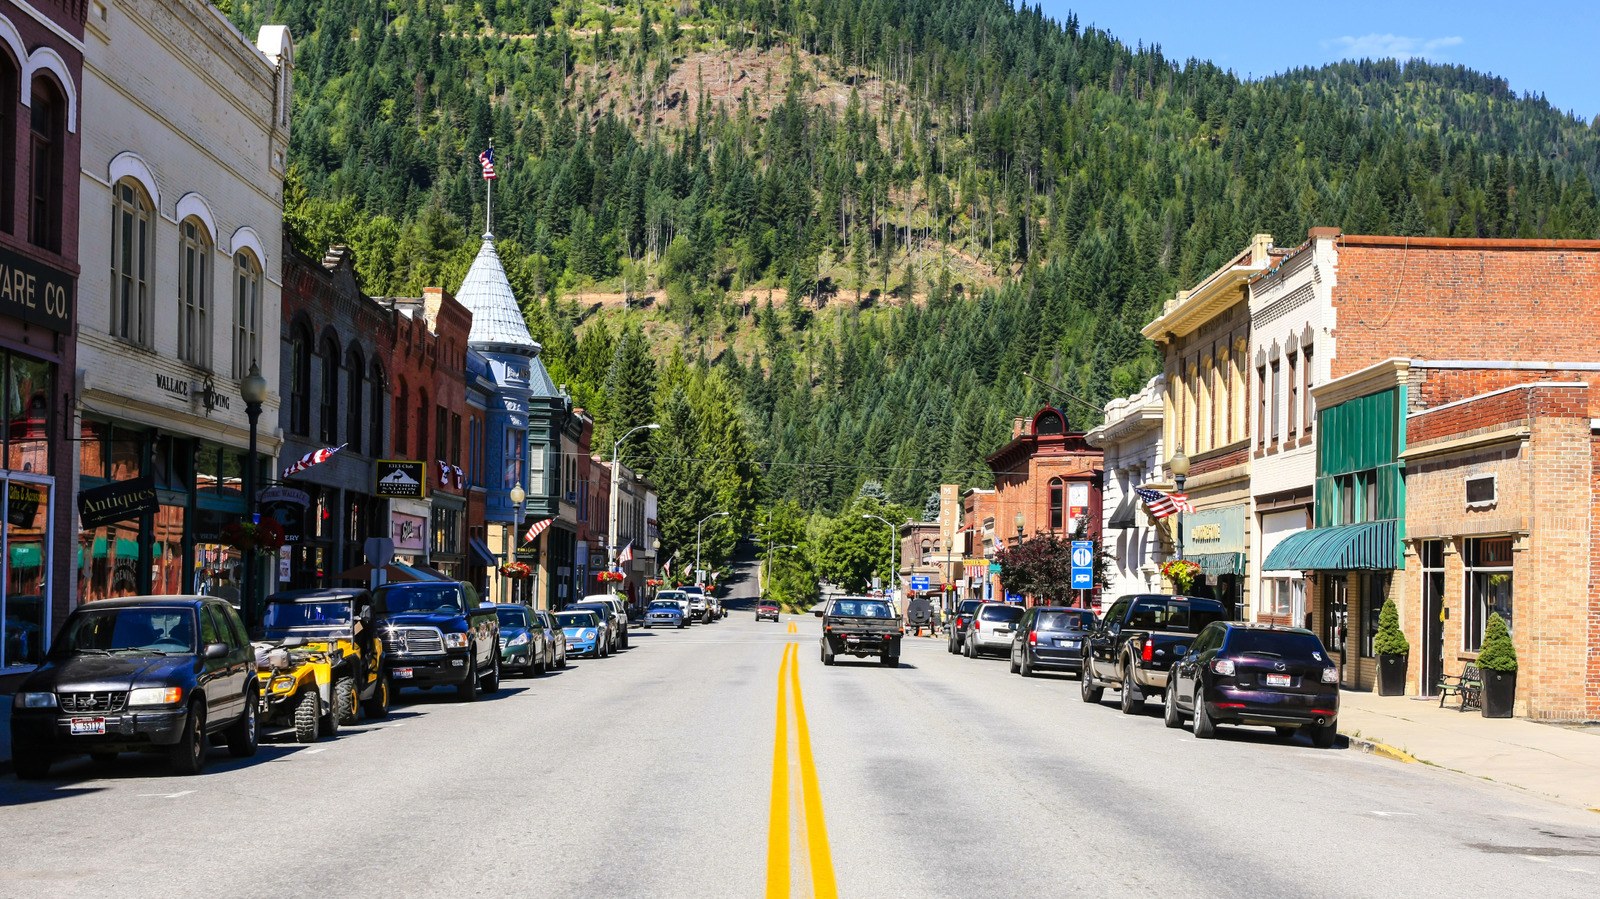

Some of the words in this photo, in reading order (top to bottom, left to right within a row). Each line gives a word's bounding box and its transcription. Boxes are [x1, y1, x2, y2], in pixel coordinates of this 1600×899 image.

[0, 263, 36, 310] ARE
[44, 281, 68, 320] CO.
[156, 373, 188, 396] WALLACE
[83, 488, 155, 514] Antiques
